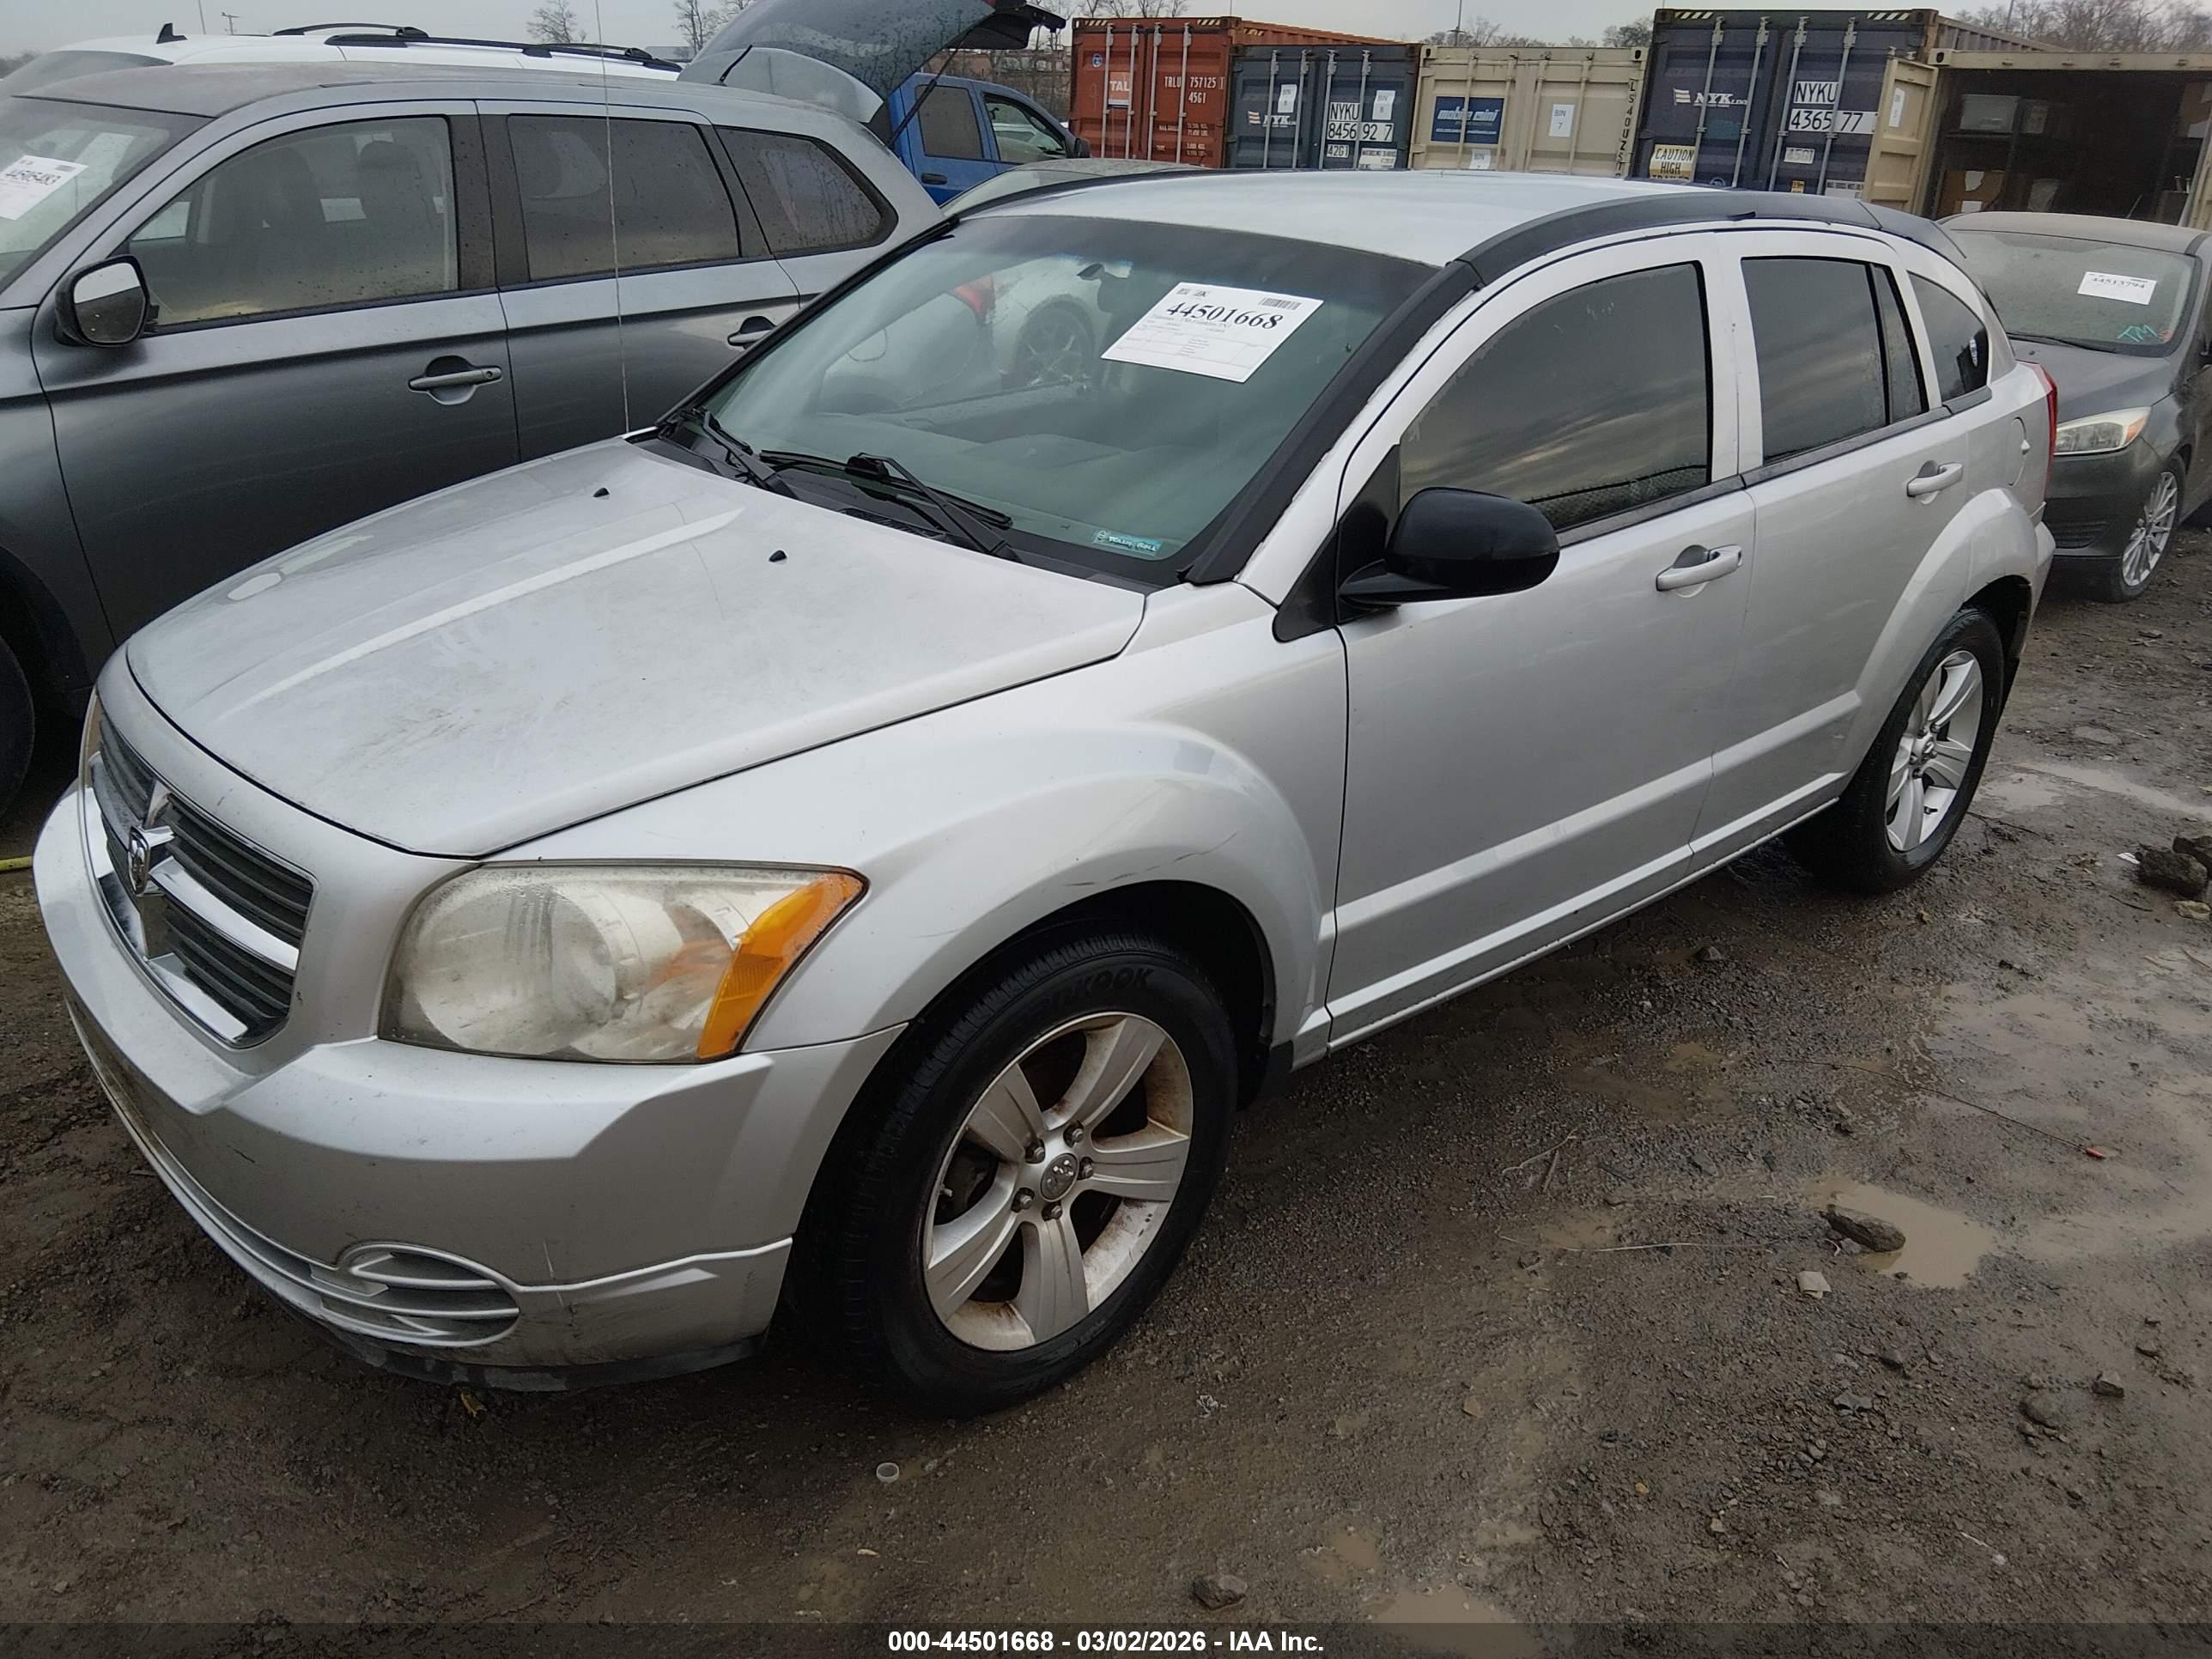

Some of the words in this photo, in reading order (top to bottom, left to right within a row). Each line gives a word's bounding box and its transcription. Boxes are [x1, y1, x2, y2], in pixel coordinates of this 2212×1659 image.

[1109, 81, 1131, 91] TAL
[1164, 76, 1182, 88] TRLU
[1189, 76, 1217, 88] 757125
[1796, 82, 1838, 102] NYKU
[1331, 104, 1360, 120] NYKU
[1384, 125, 1393, 141] 7
[1655, 148, 1695, 161] CAUTION
[1660, 162, 1681, 175] HIGH
[1167, 301, 1284, 330] 44501668
